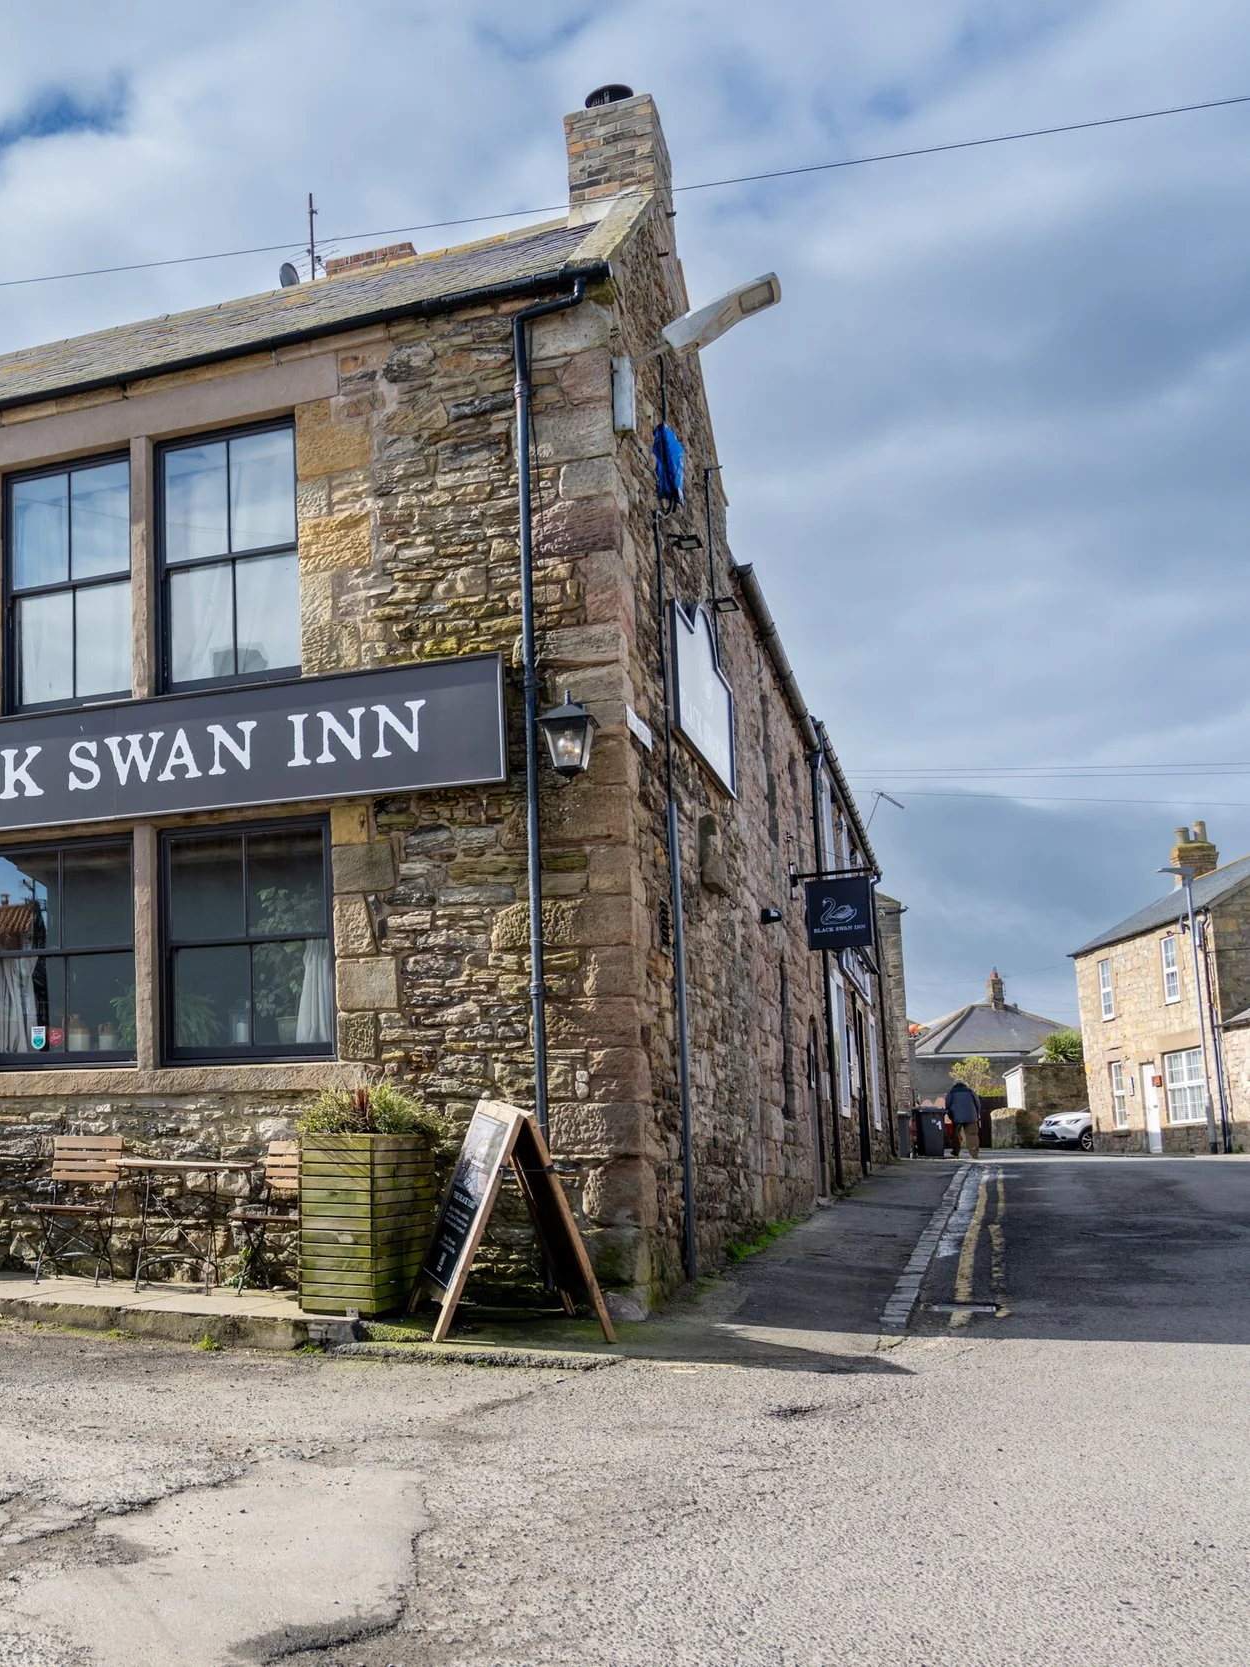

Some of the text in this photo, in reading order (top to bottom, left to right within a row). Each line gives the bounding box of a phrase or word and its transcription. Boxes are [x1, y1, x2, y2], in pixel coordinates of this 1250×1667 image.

[68, 720, 257, 791] SWAN
[286, 699, 426, 768] INN
[936, 1120, 942, 1130] 1
